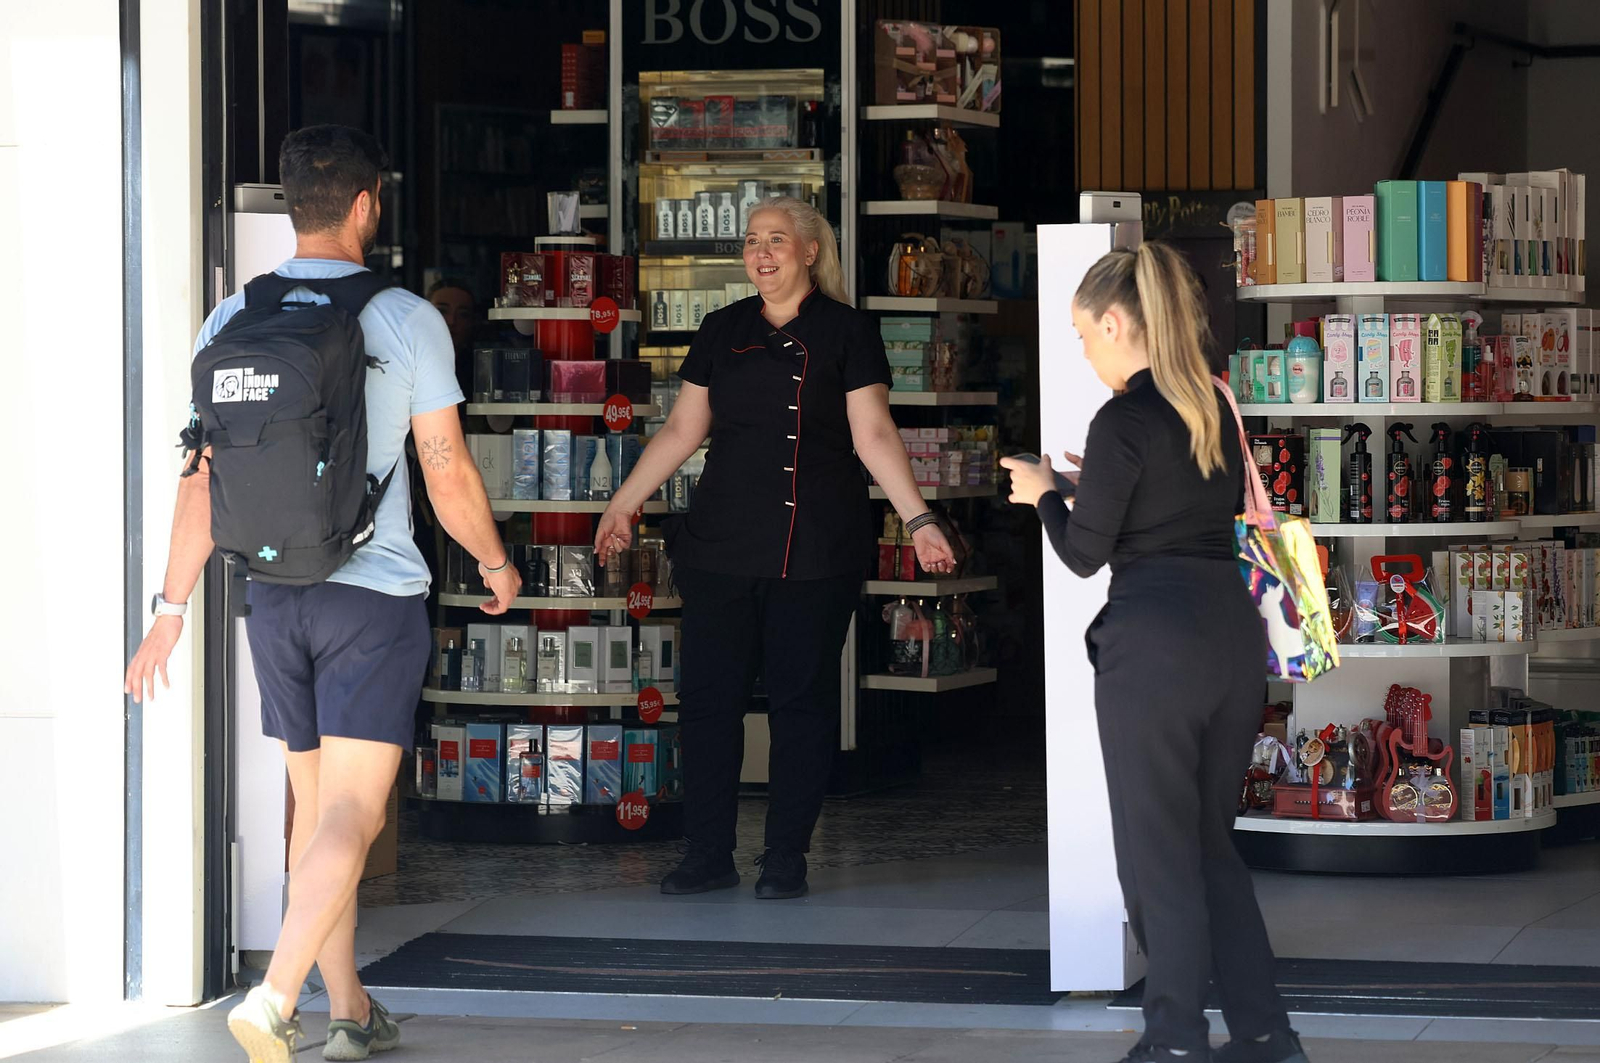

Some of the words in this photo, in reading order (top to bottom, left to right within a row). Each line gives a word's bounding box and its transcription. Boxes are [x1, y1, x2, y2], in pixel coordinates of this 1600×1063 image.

[641, 0, 822, 45] BOSS
[701, 208, 709, 232] BOSS
[714, 241, 744, 254] BOS
[243, 374, 279, 388] INDIAN
[243, 388, 268, 402] FACE
[482, 448, 494, 470] ck
[674, 476, 682, 498] BOSS
